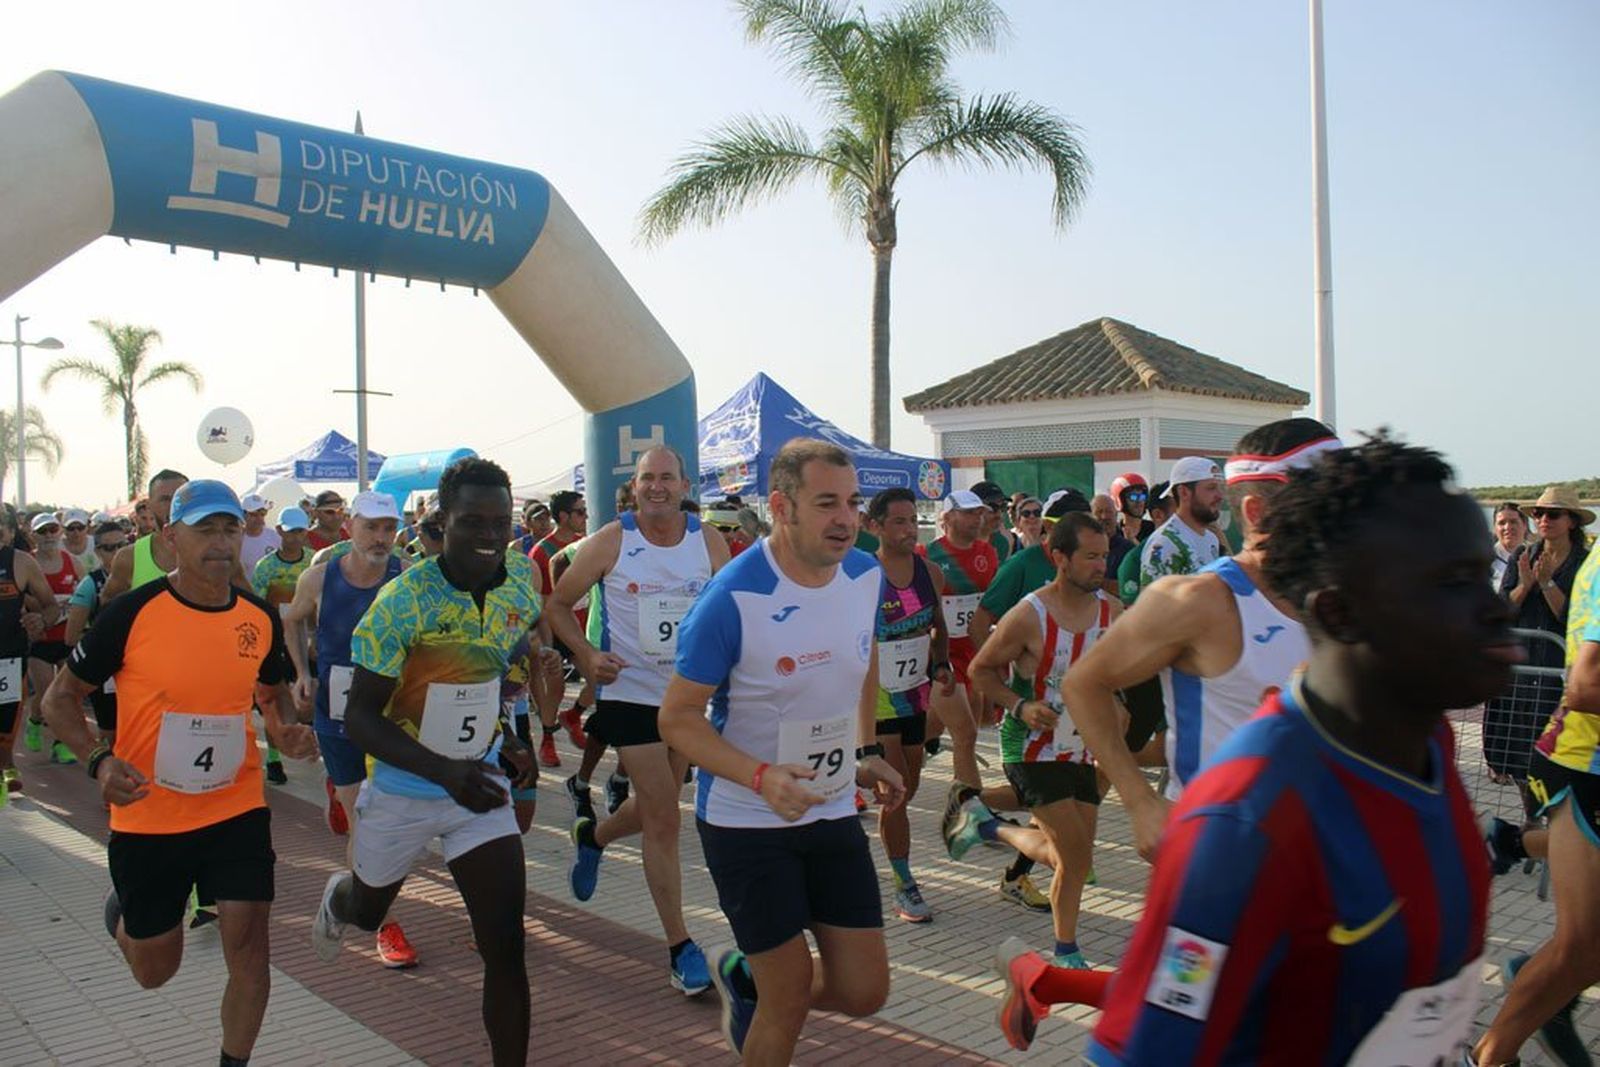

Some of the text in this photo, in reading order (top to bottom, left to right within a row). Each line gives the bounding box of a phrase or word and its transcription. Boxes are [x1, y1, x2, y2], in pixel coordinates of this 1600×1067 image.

[189, 118, 282, 206] H
[300, 139, 517, 210] DIPUTACIÓN
[298, 179, 495, 245] DE HUELVA
[618, 425, 664, 464] H
[863, 471, 901, 485] Deportes
[658, 621, 679, 642] 9
[896, 658, 918, 678] 72
[458, 715, 477, 743] 5
[194, 746, 214, 773] 4
[808, 747, 844, 778] 79
